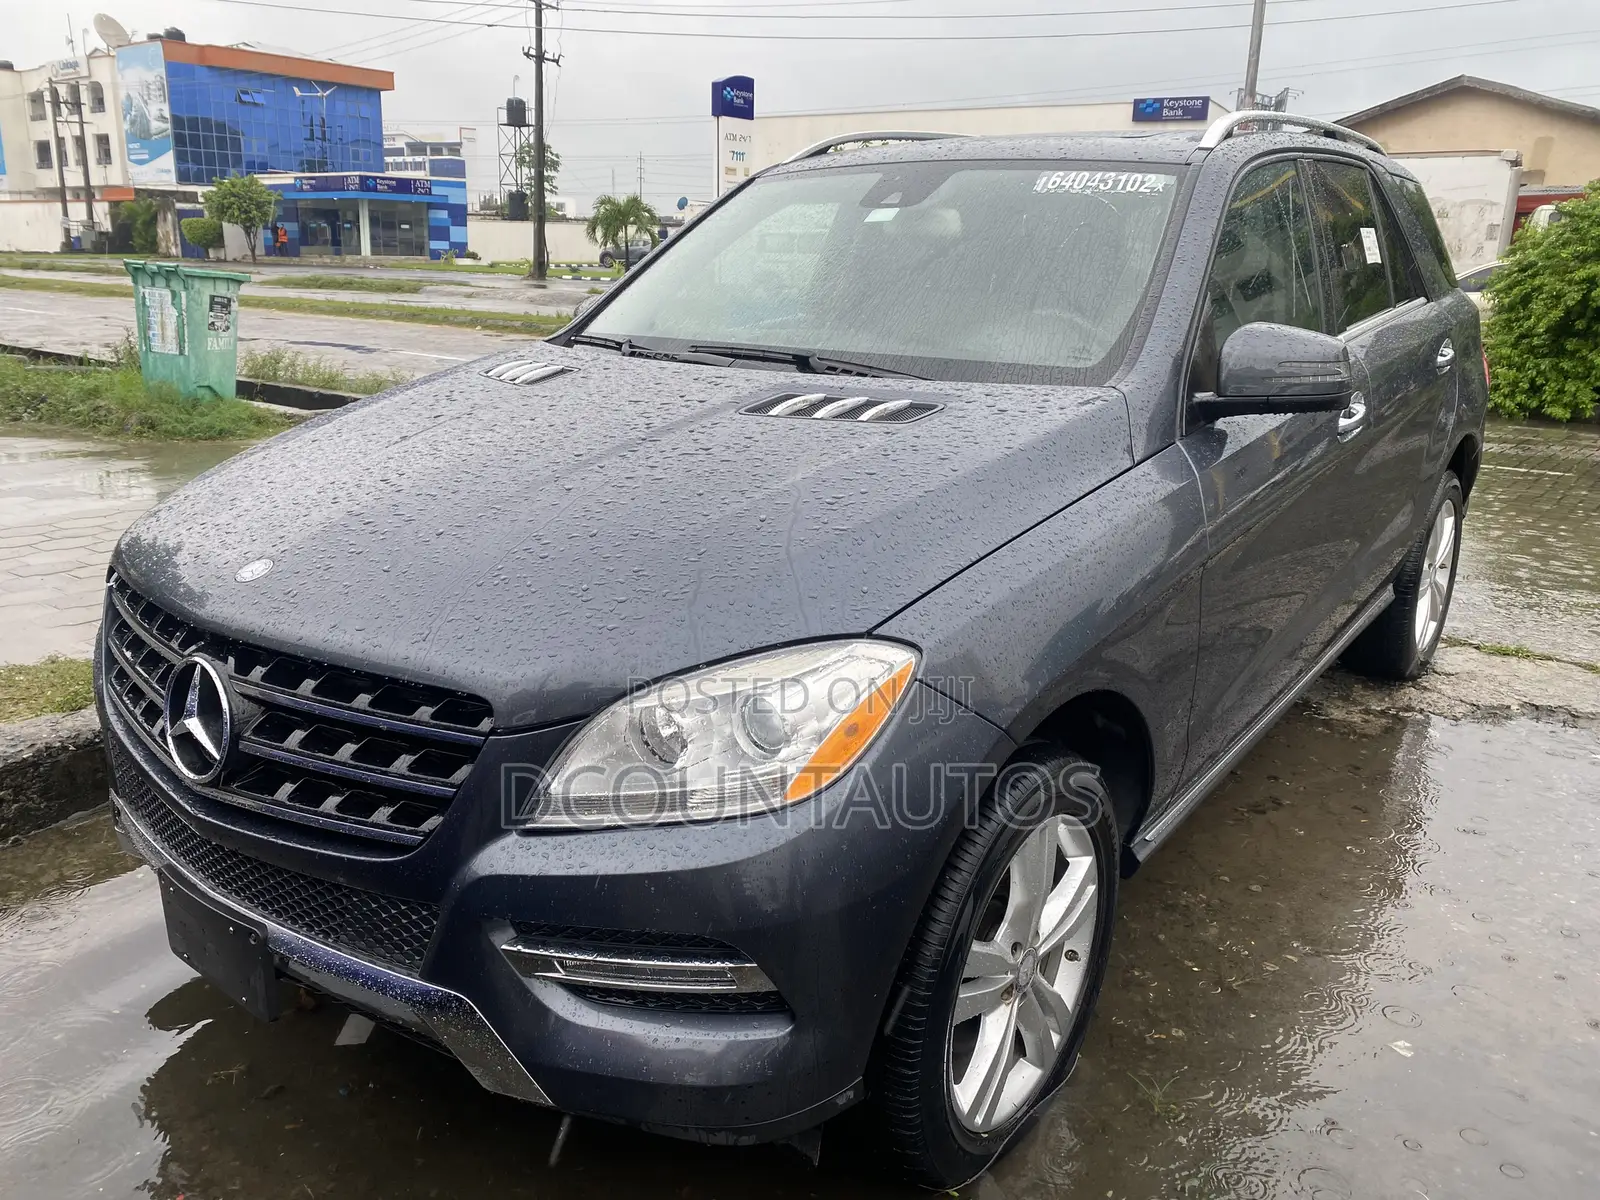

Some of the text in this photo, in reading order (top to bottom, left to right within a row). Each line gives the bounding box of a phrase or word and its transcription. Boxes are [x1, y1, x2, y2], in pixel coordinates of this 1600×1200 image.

[733, 88, 753, 98] Keystone
[733, 96, 745, 105] Bank
[1163, 99, 1203, 109] Keystone
[1162, 108, 1184, 117] Bank
[724, 132, 752, 143] ATM 24/7
[376, 178, 397, 187] Keystone
[415, 180, 431, 188] ATM
